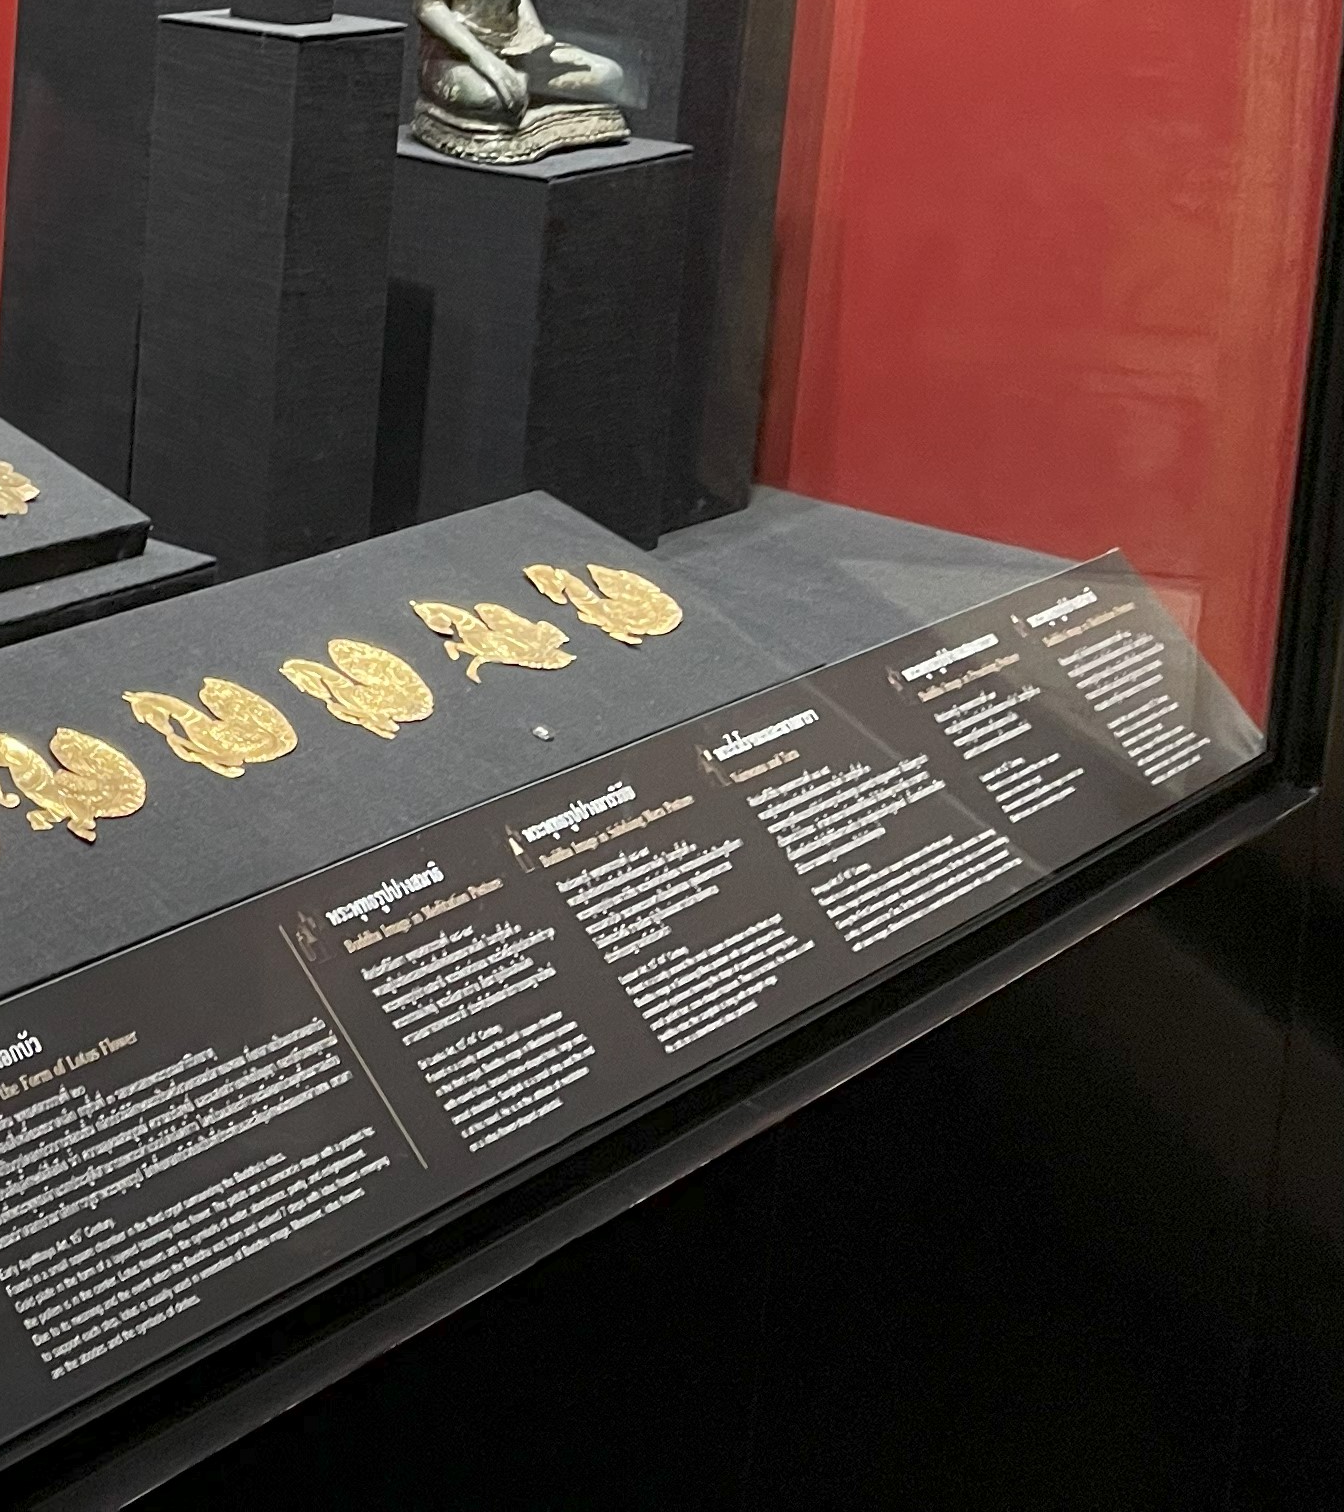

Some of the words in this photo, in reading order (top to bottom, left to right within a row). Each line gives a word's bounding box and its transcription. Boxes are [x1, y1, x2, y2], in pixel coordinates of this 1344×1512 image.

[18, 1069, 54, 1091] Form
[53, 1057, 66, 1076] of
[65, 1048, 100, 1070] Lotus
[98, 1030, 138, 1056] Flower
